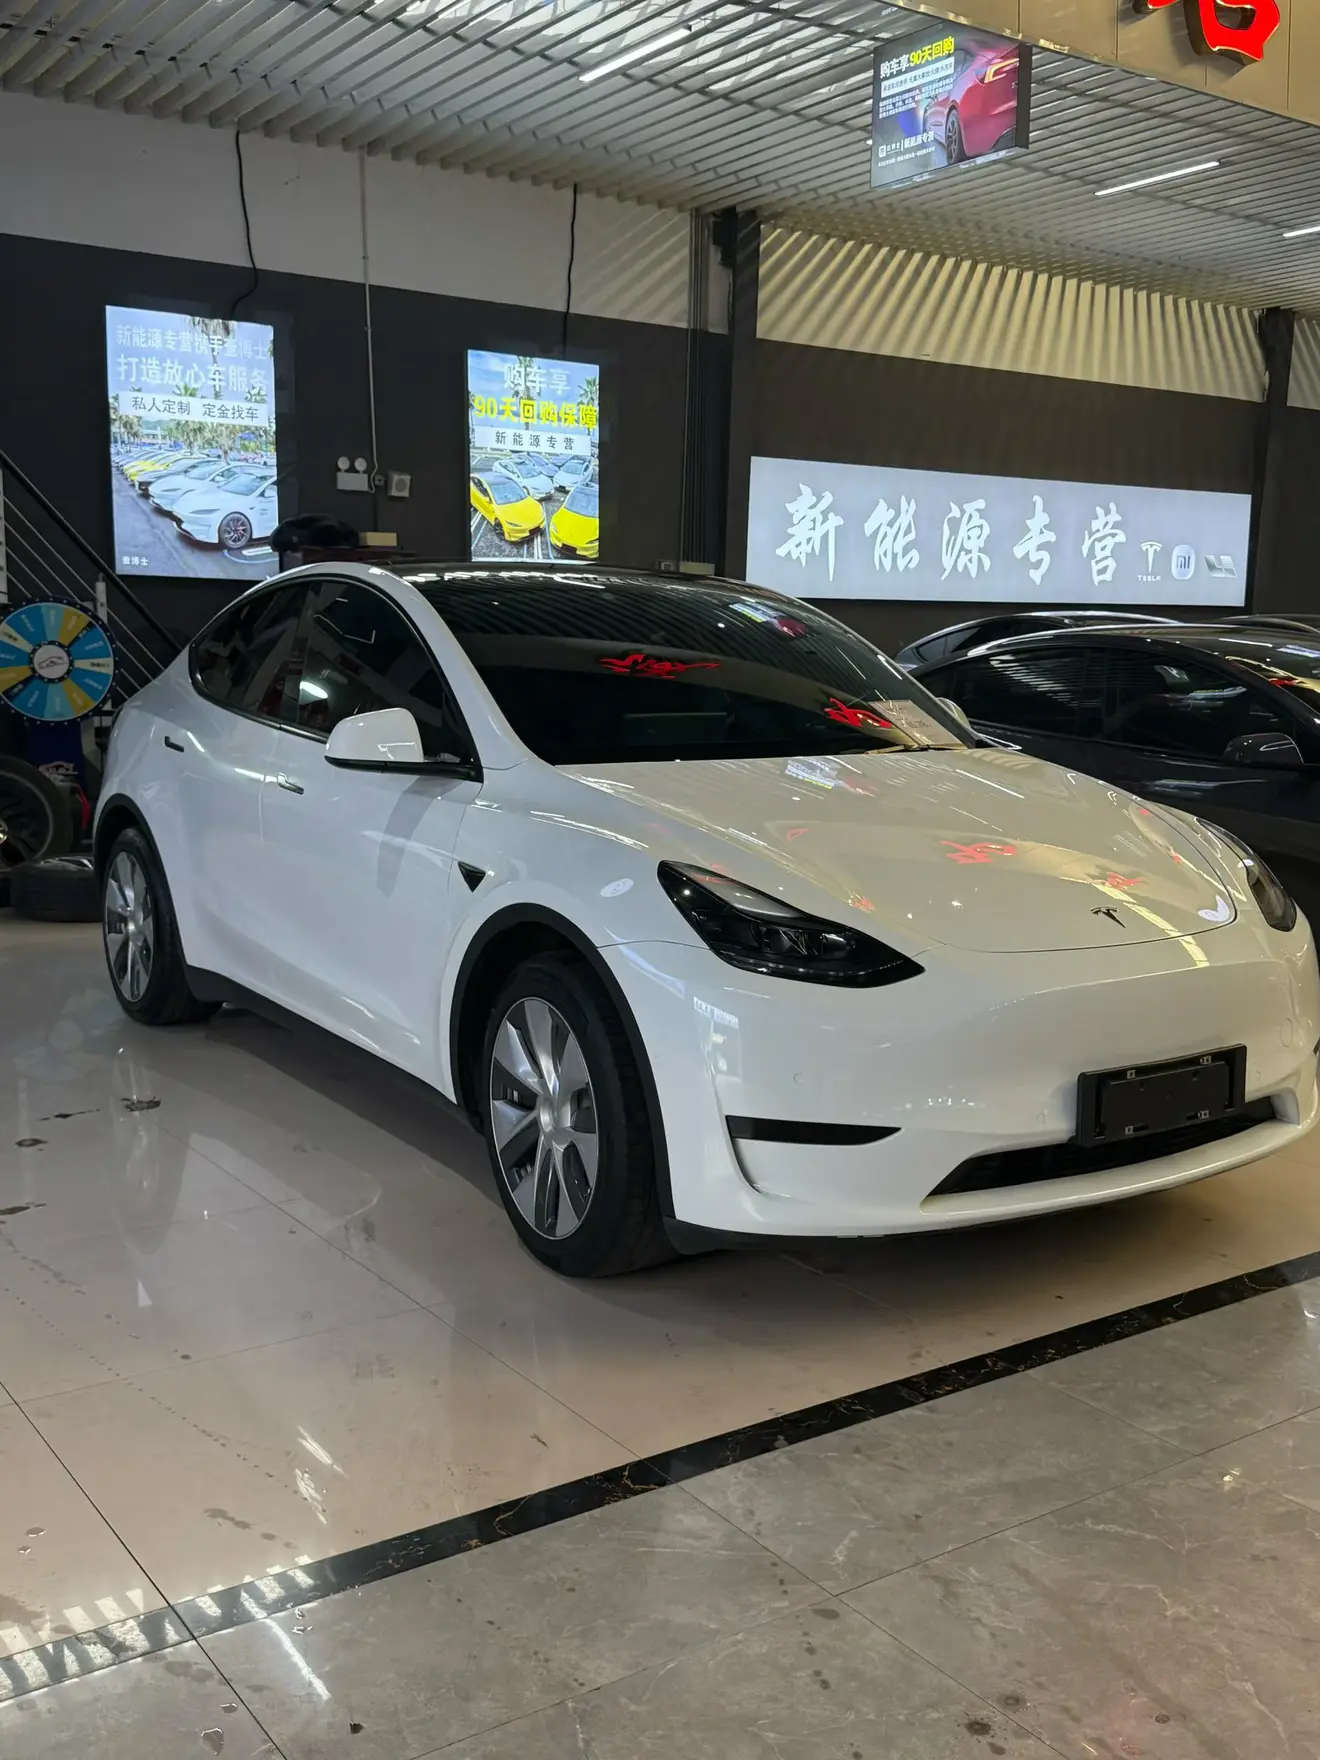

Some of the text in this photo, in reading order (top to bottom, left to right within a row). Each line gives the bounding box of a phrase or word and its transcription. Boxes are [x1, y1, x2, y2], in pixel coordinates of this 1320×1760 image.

[880, 36, 954, 78] 购车享90天回购
[117, 354, 268, 393] 打造放心车服务
[504, 364, 571, 394] 购车享
[132, 398, 259, 422] 私人定制 定金找车
[473, 395, 598, 431] 90天回购保障
[495, 430, 575, 451] 新能源专营
[775, 483, 1127, 587] 新能源专营
[1137, 574, 1162, 583] TESLA
